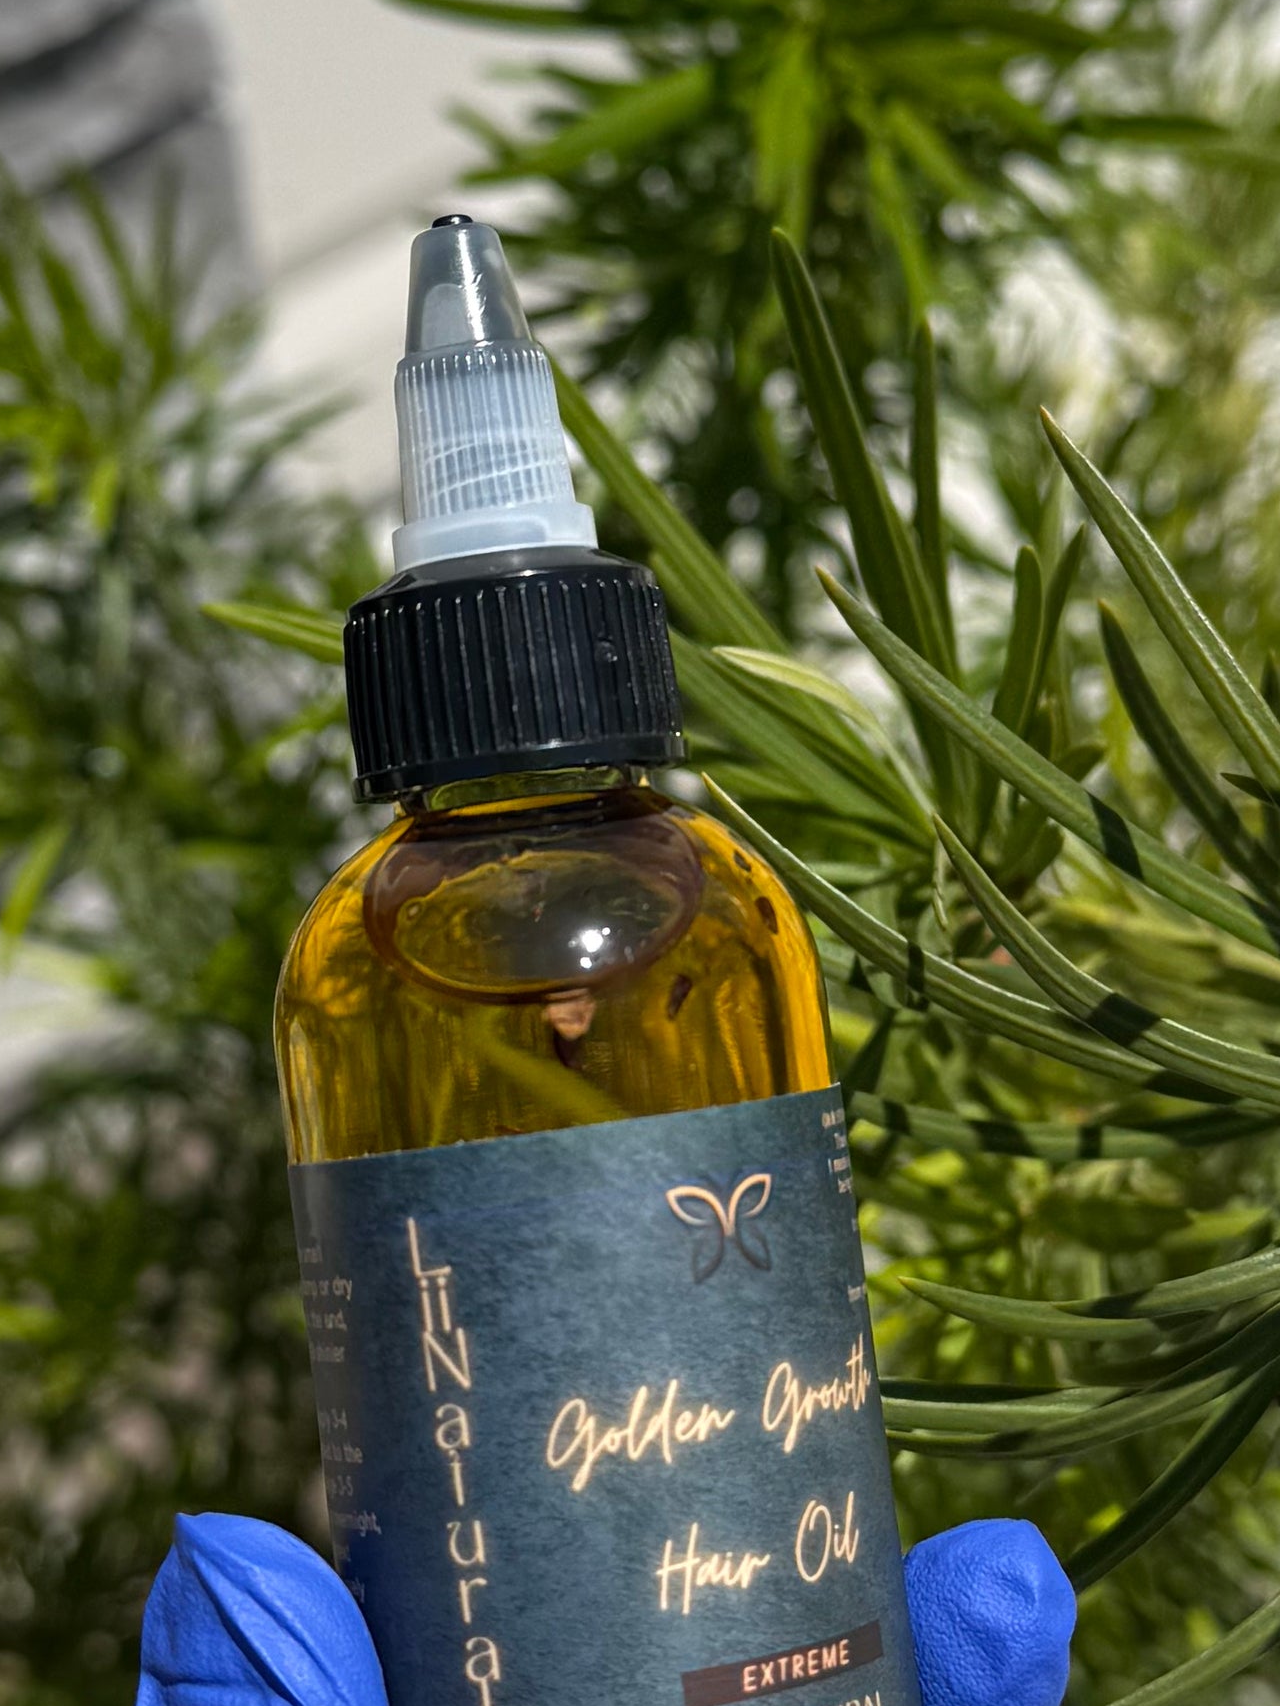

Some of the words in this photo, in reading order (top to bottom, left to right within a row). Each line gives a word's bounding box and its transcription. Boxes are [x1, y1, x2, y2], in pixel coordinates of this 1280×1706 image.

[546, 1378, 736, 1493] Golden
[762, 1332, 871, 1454] Growth
[655, 1521, 771, 1615] Hair
[794, 1490, 860, 1583] Oil
[741, 1638, 851, 1693] EXTREME
